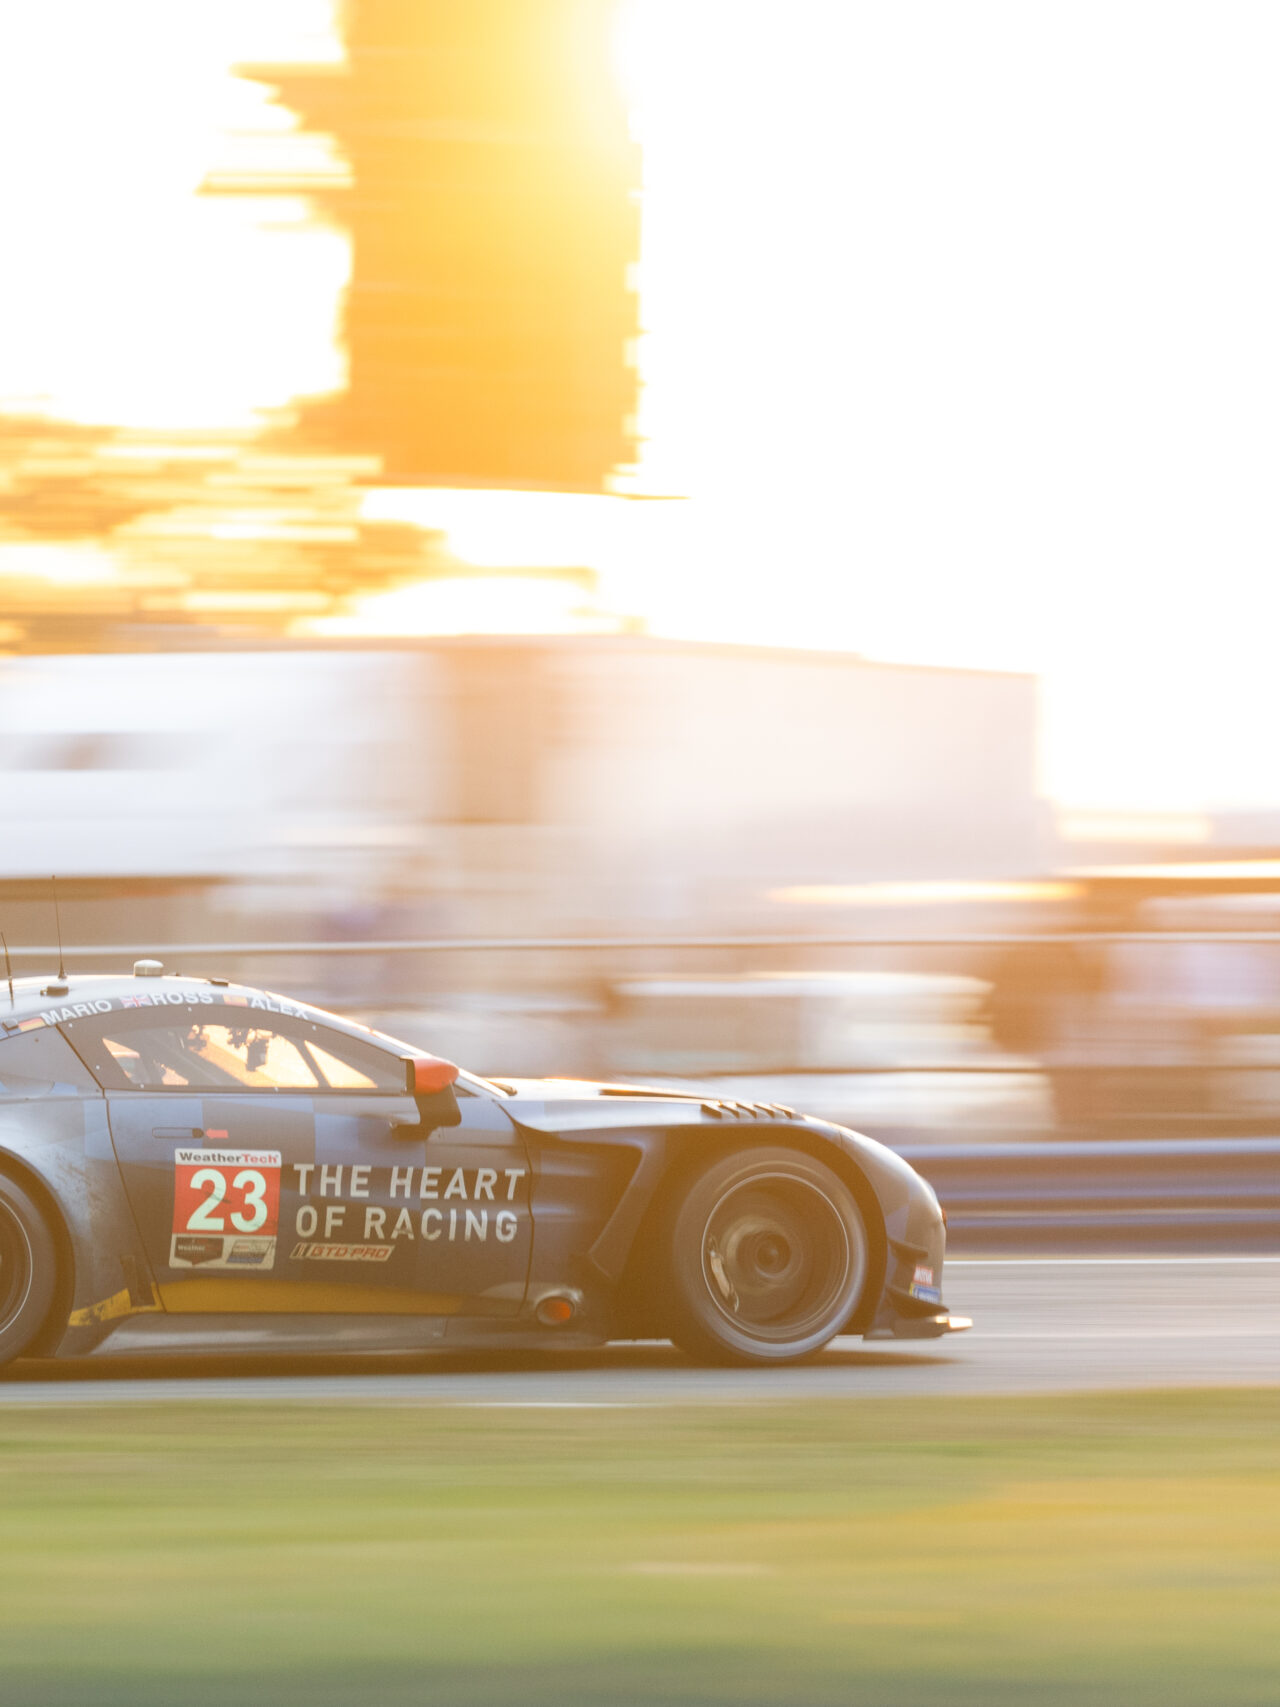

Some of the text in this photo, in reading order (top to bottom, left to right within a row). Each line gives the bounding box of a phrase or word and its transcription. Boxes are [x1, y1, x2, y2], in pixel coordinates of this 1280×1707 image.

[151, 991, 214, 1006] ROSS
[250, 998, 309, 1020] ALEX
[40, 1000, 112, 1025] MARIO
[179, 1151, 277, 1164] WeatherTech
[293, 1163, 525, 1200] THE HEART
[186, 1168, 268, 1232] 23
[295, 1205, 518, 1243] OF RACING
[311, 1245, 390, 1259] GTD PRO
